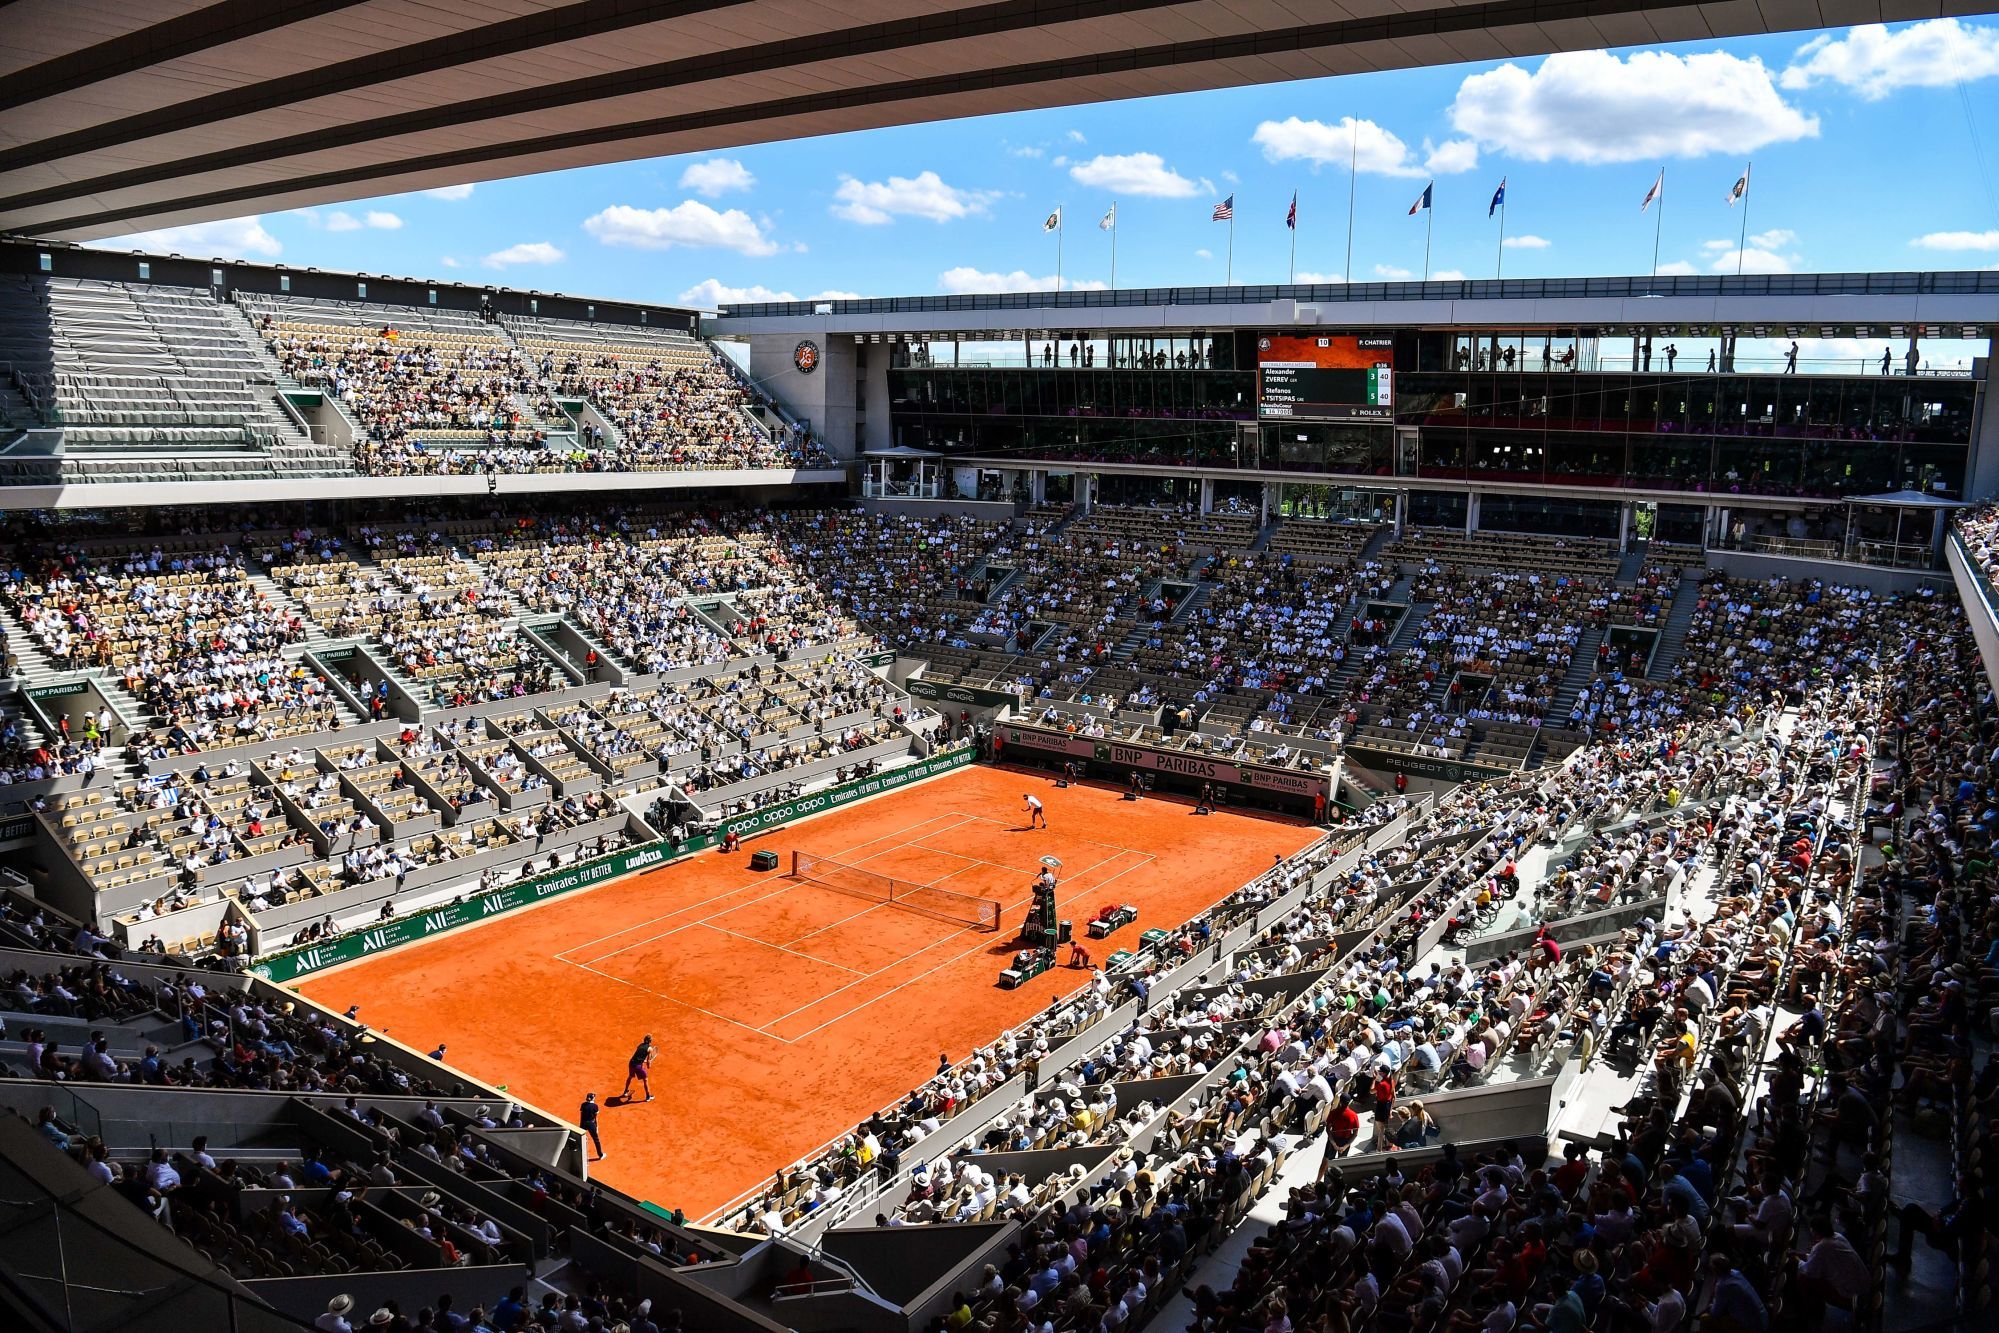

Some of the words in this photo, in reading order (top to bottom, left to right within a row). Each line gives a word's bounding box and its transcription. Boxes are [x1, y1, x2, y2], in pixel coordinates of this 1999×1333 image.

[48, 685, 83, 695] PARIBAS
[1022, 733, 1036, 741] BNP
[1038, 735, 1066, 747] PARIBAS
[929, 759, 952, 772] Emirates
[1115, 748, 1142, 764] BNP
[1156, 755, 1215, 777] PARIBAS
[1386, 758, 1442, 772] PEUGEOT
[882, 773, 907, 787] Emirates
[1254, 773, 1271, 782] BNP
[1273, 777, 1308, 789] PARIBAS
[830, 789, 858, 803] Emirates
[866, 781, 879, 793] BETTER
[797, 797, 825, 812] oppo
[763, 807, 792, 823] oppo
[728, 817, 759, 833] oppo
[626, 850, 663, 869] LAVAZZA
[536, 876, 578, 896] Emirates
[580, 870, 591, 883] FLY
[591, 863, 612, 879] BETTER
[504, 899, 523, 908] LIMITLESS
[448, 916, 469, 926] LIMITLESS
[387, 935, 410, 945] LIMITLESS
[322, 954, 347, 965] LIMITLESS
